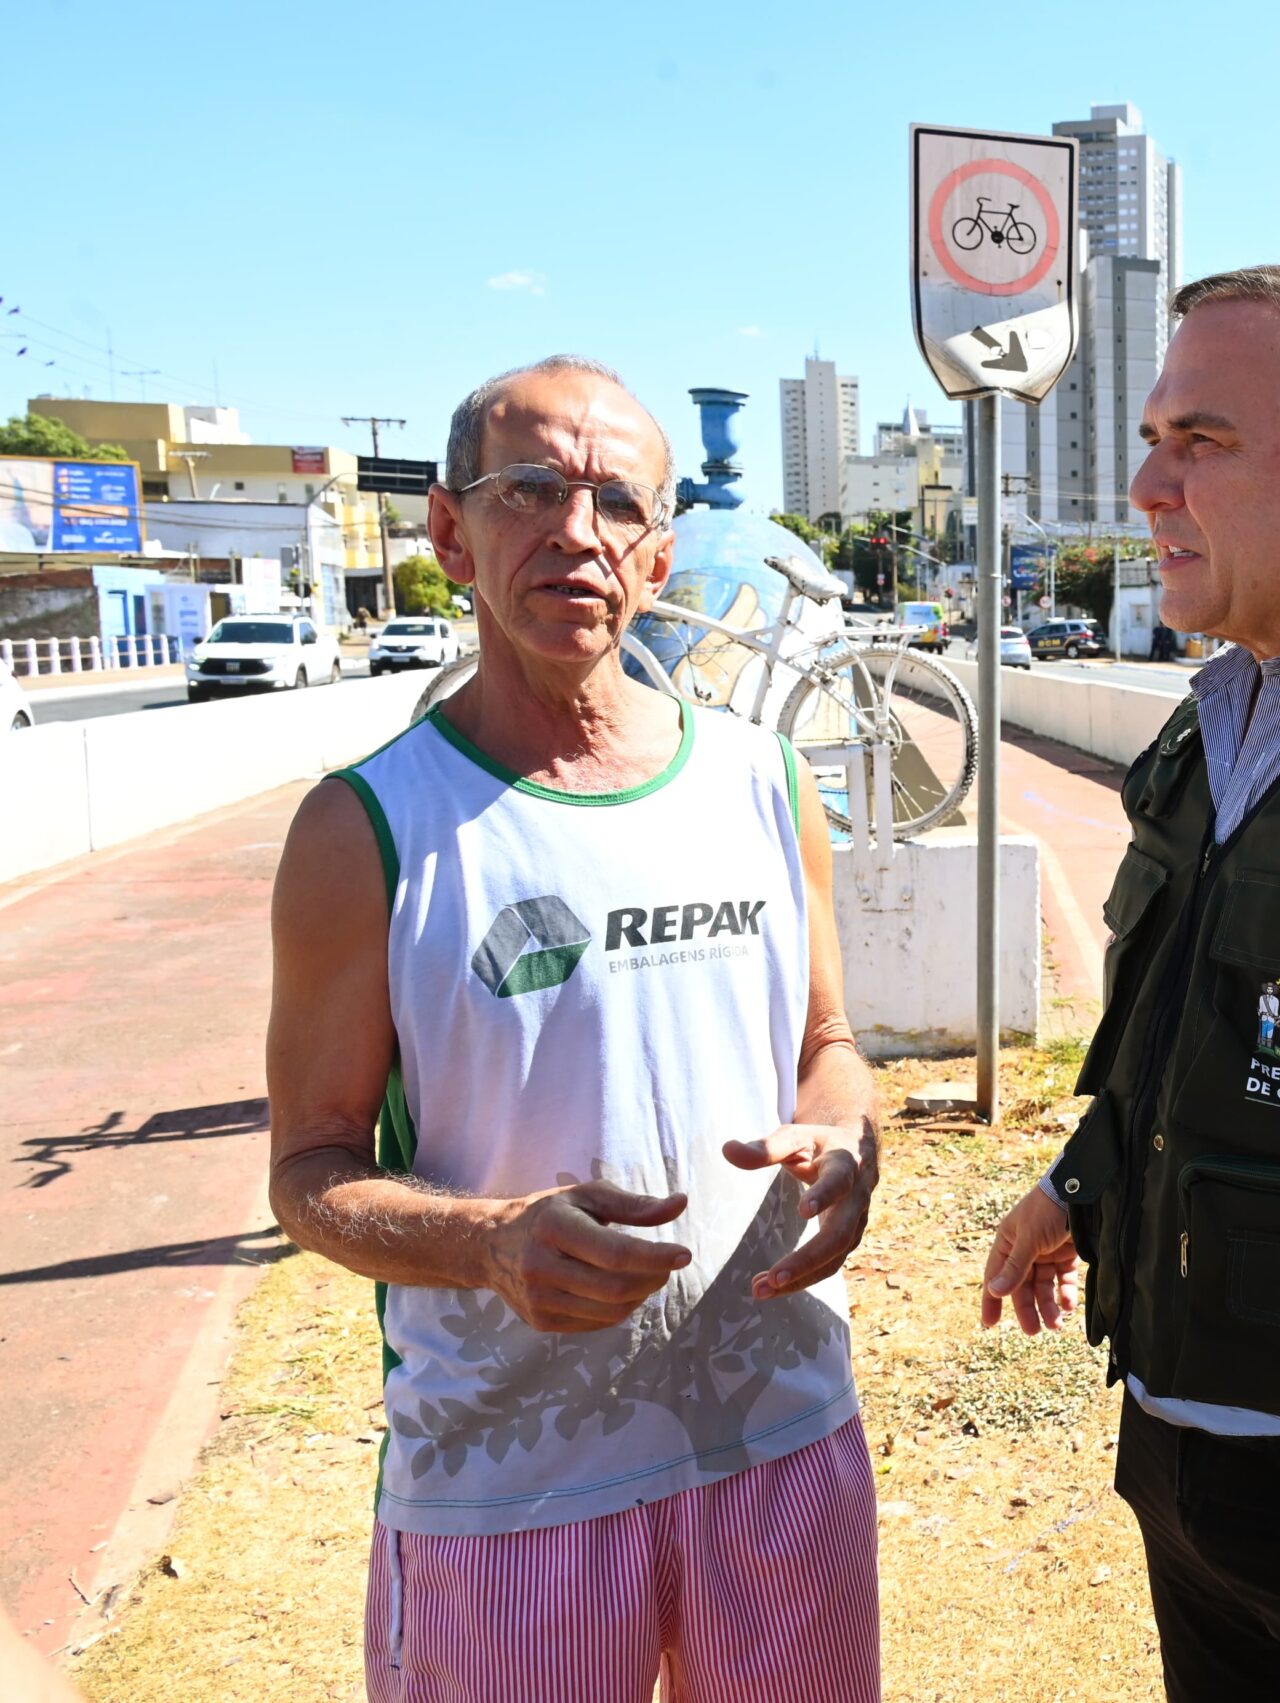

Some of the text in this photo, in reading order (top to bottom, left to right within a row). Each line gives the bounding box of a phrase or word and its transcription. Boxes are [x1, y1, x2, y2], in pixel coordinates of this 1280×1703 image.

[605, 900, 767, 951] REPAK
[609, 950, 705, 974] EMBALAGENS
[1246, 1077, 1271, 1096] DE
